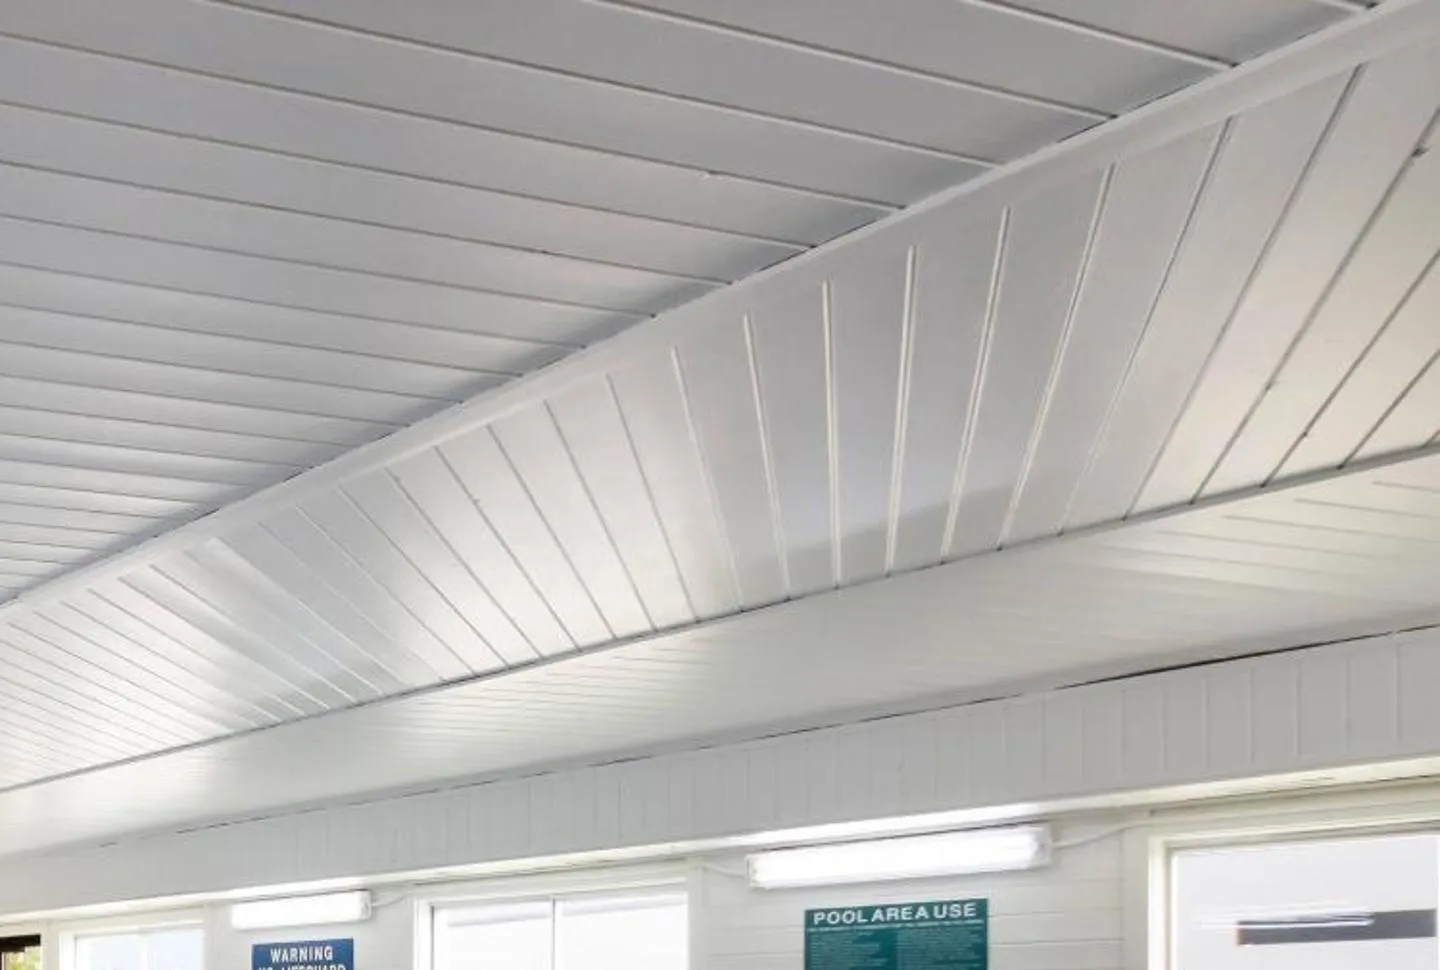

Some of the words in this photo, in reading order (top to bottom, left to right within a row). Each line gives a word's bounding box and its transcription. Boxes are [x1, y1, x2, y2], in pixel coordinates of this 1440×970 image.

[813, 911, 868, 925] POOL
[871, 906, 930, 922] AREA
[933, 902, 977, 919] USE
[270, 946, 333, 962] WARNING
